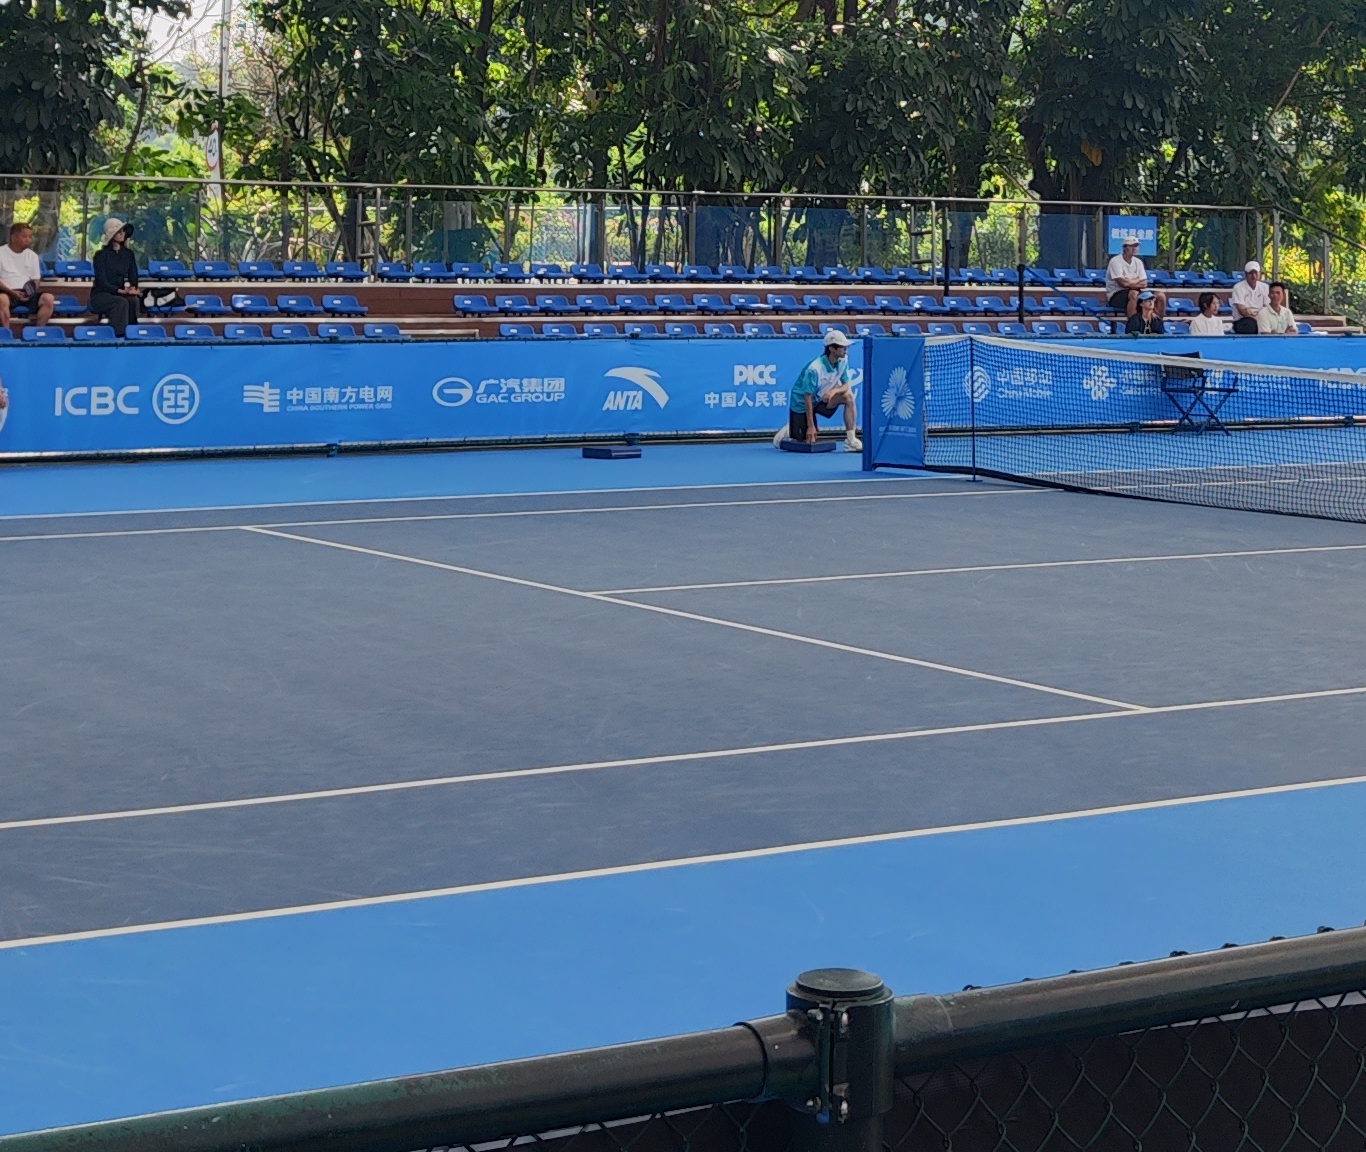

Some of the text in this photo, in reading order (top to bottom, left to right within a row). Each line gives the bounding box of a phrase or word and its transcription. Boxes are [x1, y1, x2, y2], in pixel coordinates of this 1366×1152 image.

[734, 364, 777, 385] PICC
[476, 378, 565, 393] 广汽集团
[55, 386, 140, 416] ICBC
[286, 386, 393, 404] 中国南方电网
[476, 393, 565, 403] GAC GROUP
[602, 391, 642, 411] ANTA
[704, 391, 787, 408] 中国人民保
